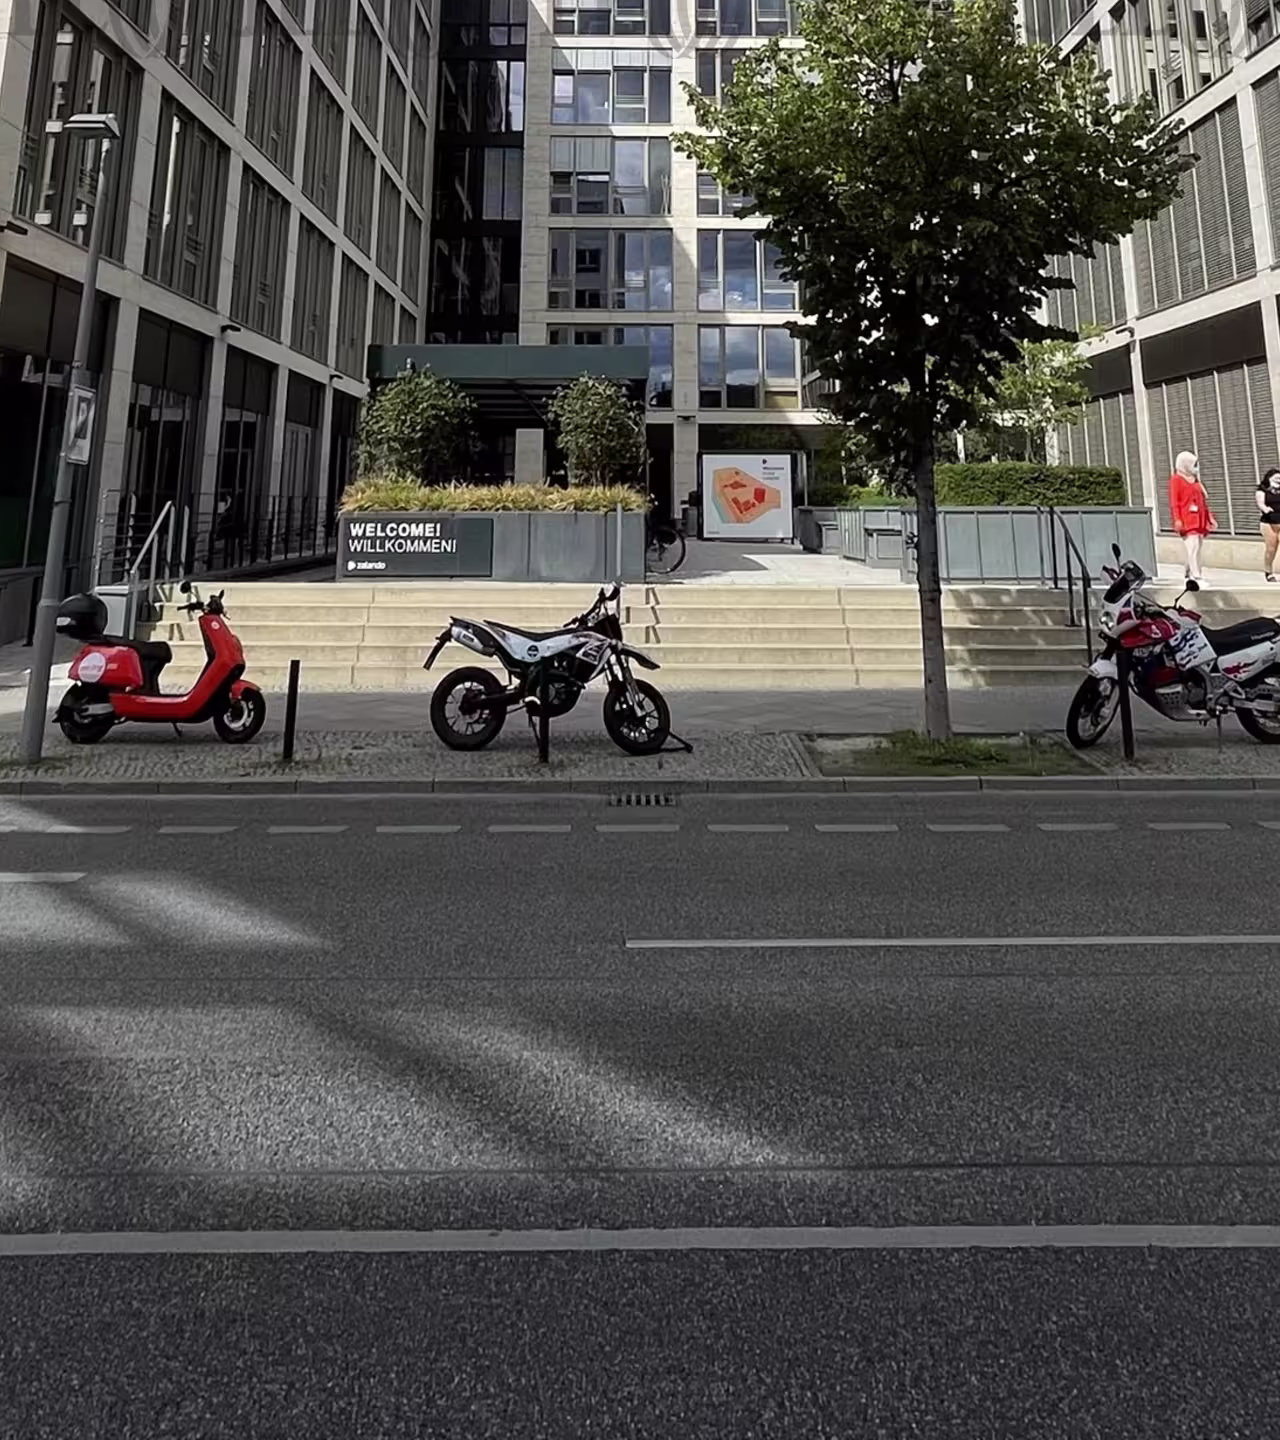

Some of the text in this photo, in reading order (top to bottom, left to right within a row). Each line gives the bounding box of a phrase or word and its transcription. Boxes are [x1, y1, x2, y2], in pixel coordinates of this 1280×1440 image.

[349, 522, 441, 537] WELCOME!
[348, 539, 457, 553] WILLKOMMEN!
[356, 561, 386, 570] zalando
